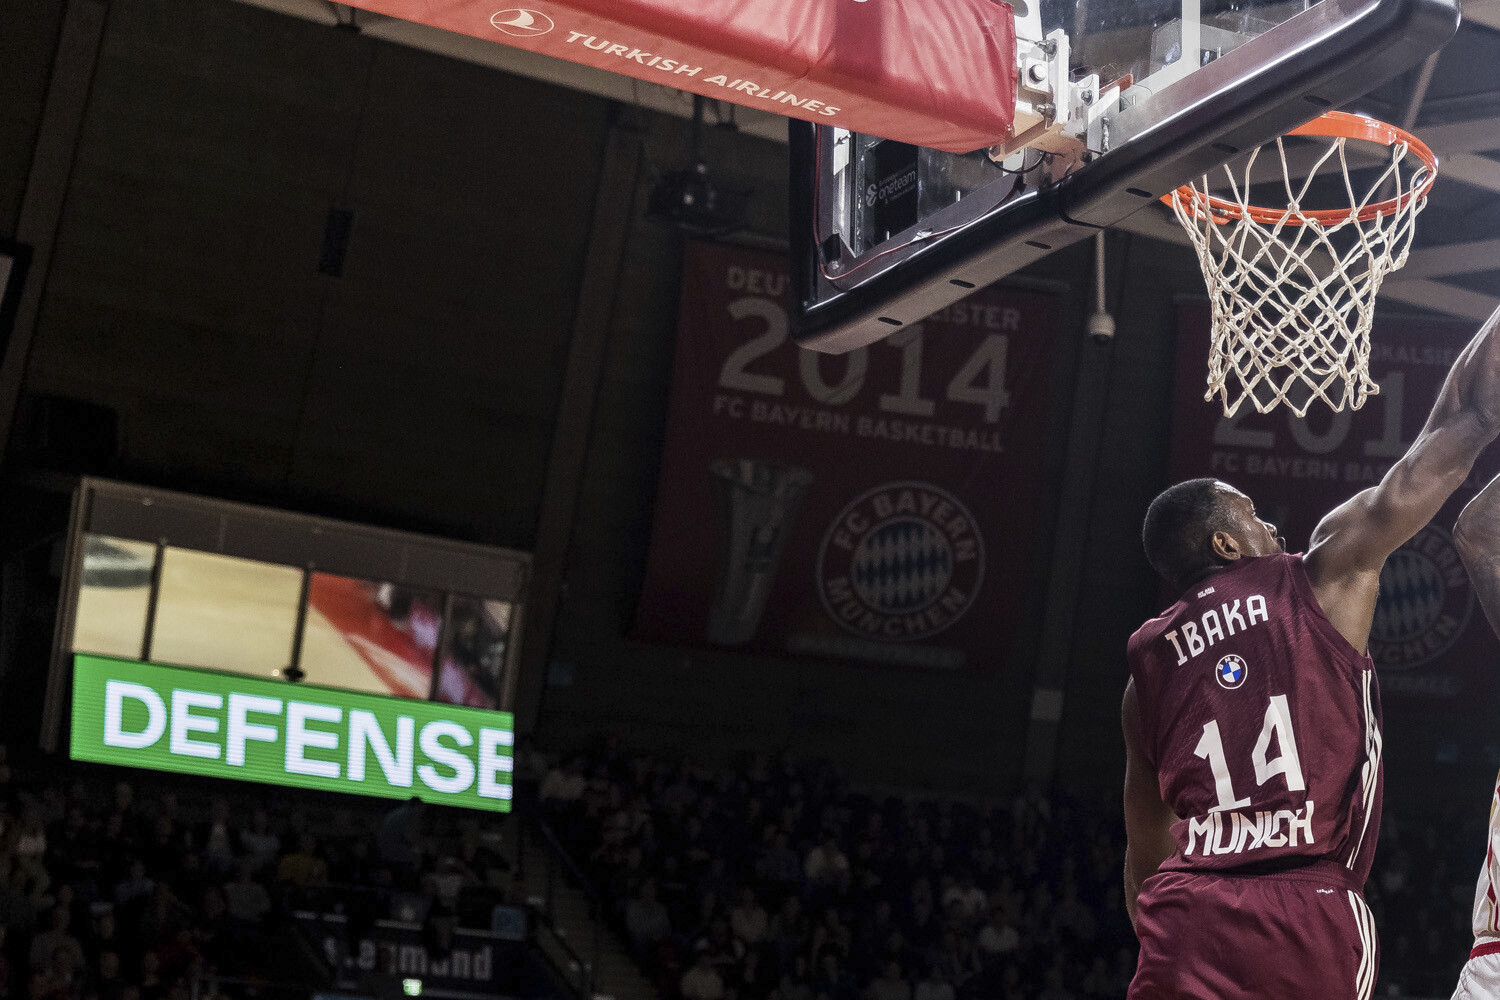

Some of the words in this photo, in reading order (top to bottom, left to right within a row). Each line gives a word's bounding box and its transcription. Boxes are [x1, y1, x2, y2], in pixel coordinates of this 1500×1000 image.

[567, 30, 702, 78] TURKISH
[703, 75, 842, 118] AIRLINES
[718, 298, 1010, 425] 2014
[857, 417, 1004, 453] BASKETBALL
[1165, 594, 1269, 667] IBAKA
[1217, 656, 1241, 671] BMW
[103, 679, 514, 800] DEFENSE
[1194, 694, 1305, 813] 14
[1184, 800, 1315, 856] MUNICH
